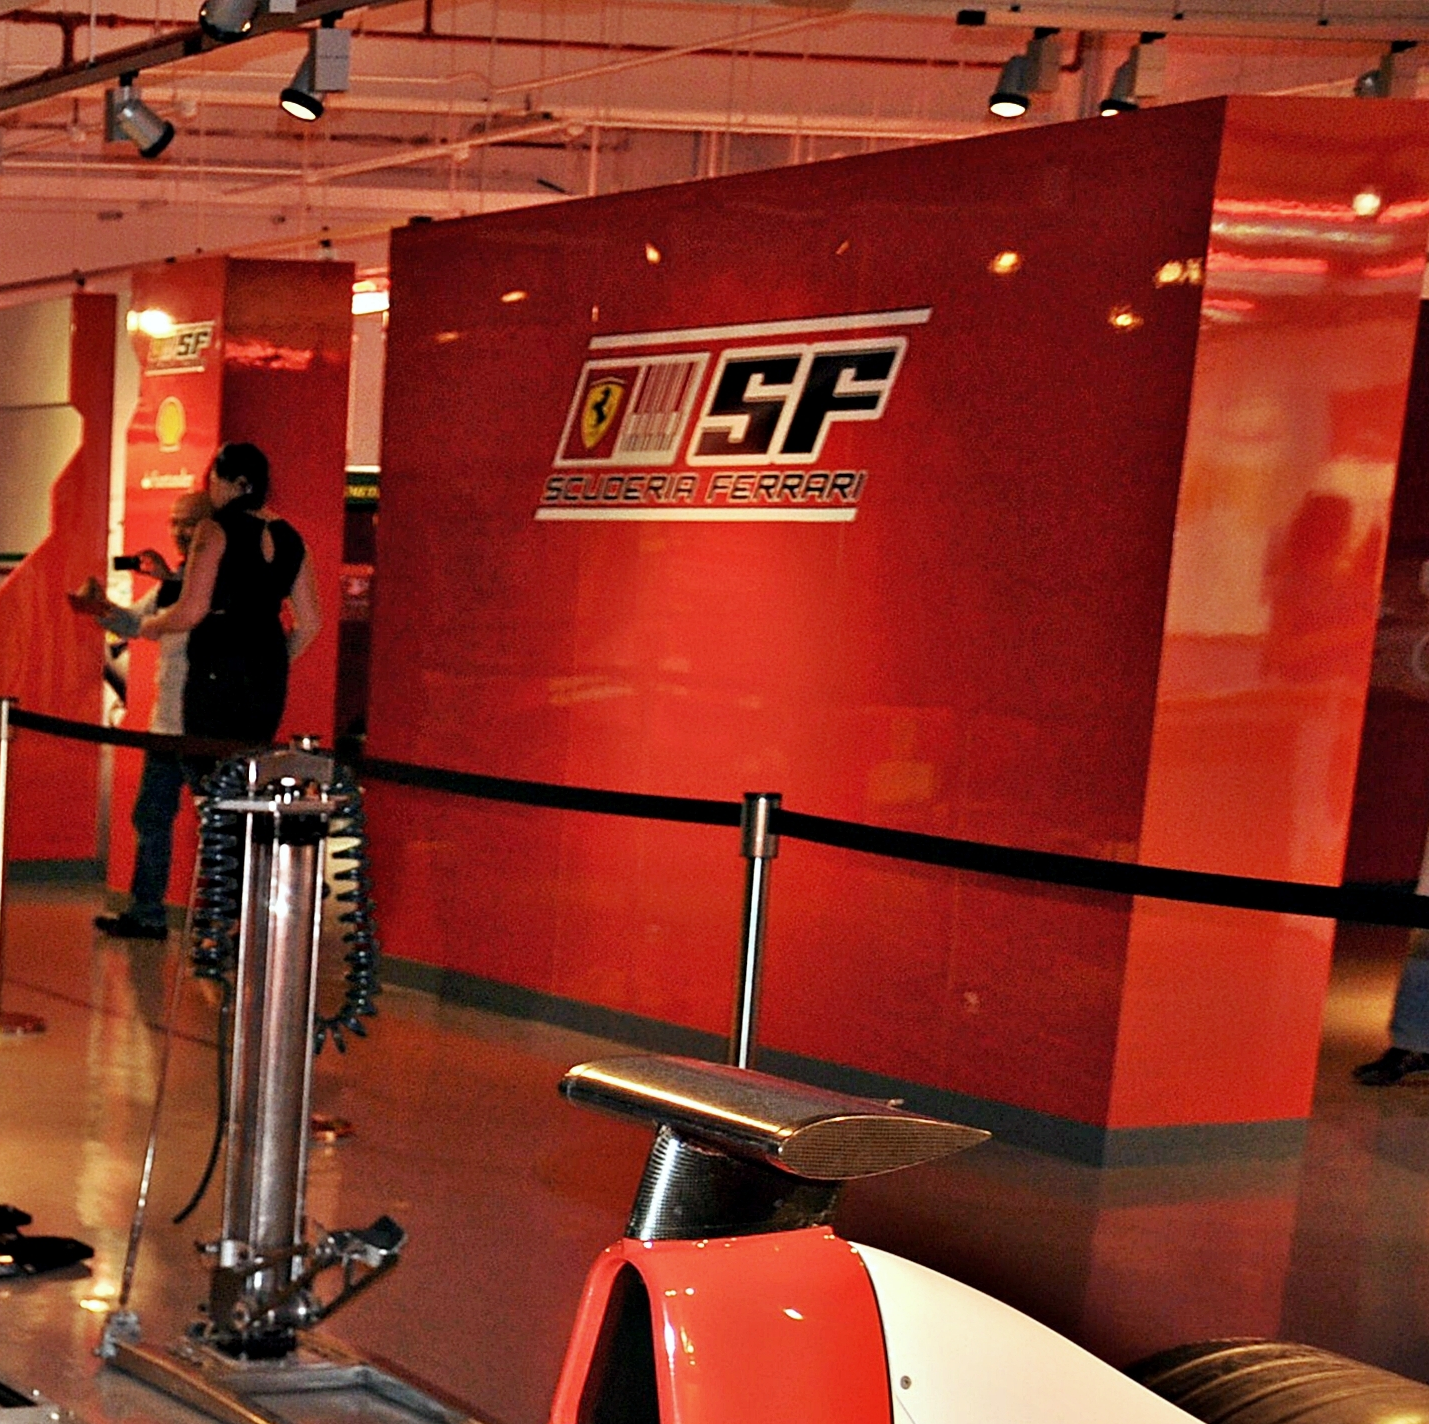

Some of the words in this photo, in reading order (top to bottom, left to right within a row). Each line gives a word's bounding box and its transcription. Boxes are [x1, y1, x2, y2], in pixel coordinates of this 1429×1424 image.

[689, 337, 906, 465] SF
[544, 472, 696, 503] SCUDERIA
[706, 469, 867, 504] FERRARI
